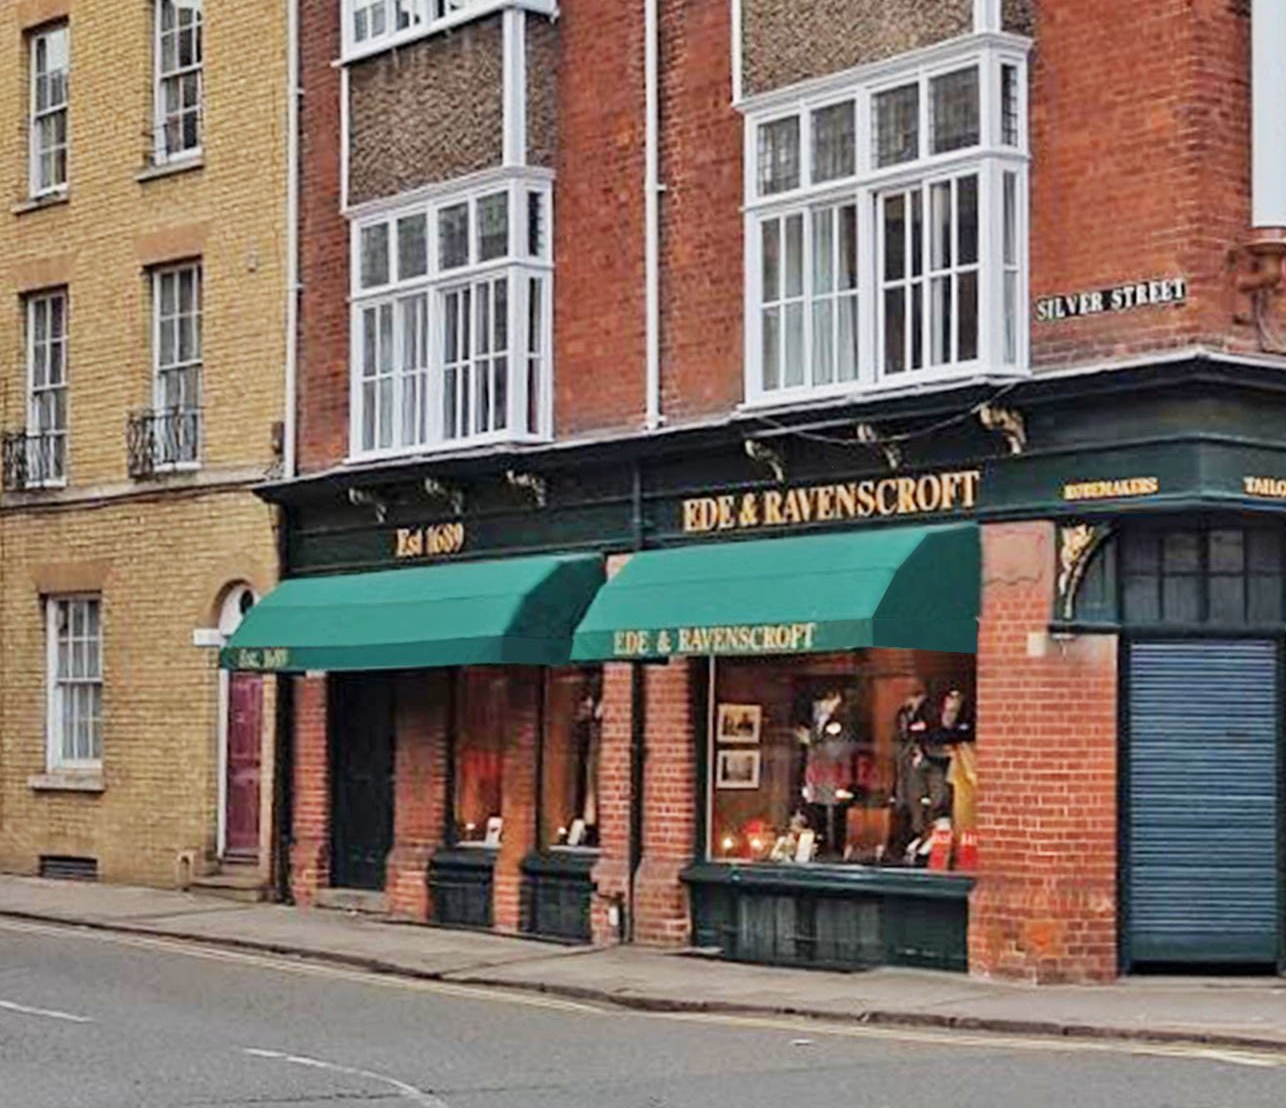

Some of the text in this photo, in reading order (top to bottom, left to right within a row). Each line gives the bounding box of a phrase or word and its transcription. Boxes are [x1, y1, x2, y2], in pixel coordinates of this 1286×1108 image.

[1037, 278, 1187, 321] SILVER STREET
[684, 470, 981, 533] EDE & RAVENSCROFT
[426, 521, 464, 554] 1689
[613, 622, 817, 655] EDE & RAVENSCROFT
